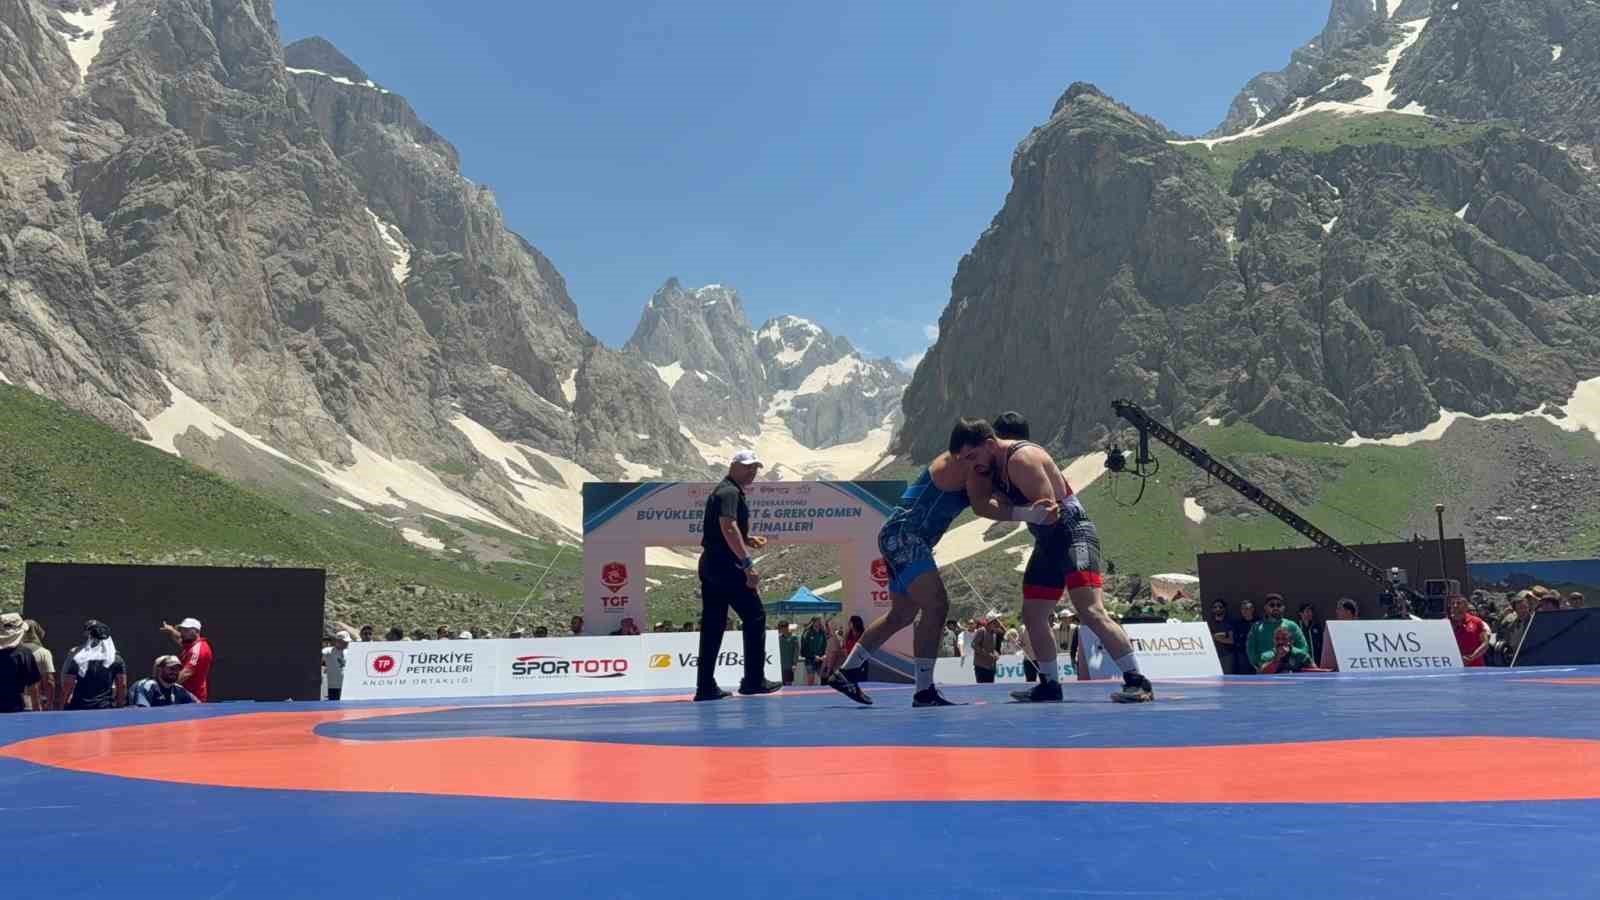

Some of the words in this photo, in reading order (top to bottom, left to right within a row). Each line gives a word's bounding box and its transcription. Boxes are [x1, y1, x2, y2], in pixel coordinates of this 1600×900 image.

[637, 507, 704, 520] BÜYÜKLER
[774, 507, 862, 519] GREKOROMEN
[752, 519, 814, 532] FİNALLERİ
[600, 596, 629, 607] TGF
[870, 591, 889, 601] TG
[1364, 631, 1422, 653] RMS
[378, 659, 391, 669] TP
[408, 652, 473, 665] TÜRKİYE
[1347, 656, 1453, 669] ZEITMEISTER
[406, 664, 473, 674] PETROLLERİ
